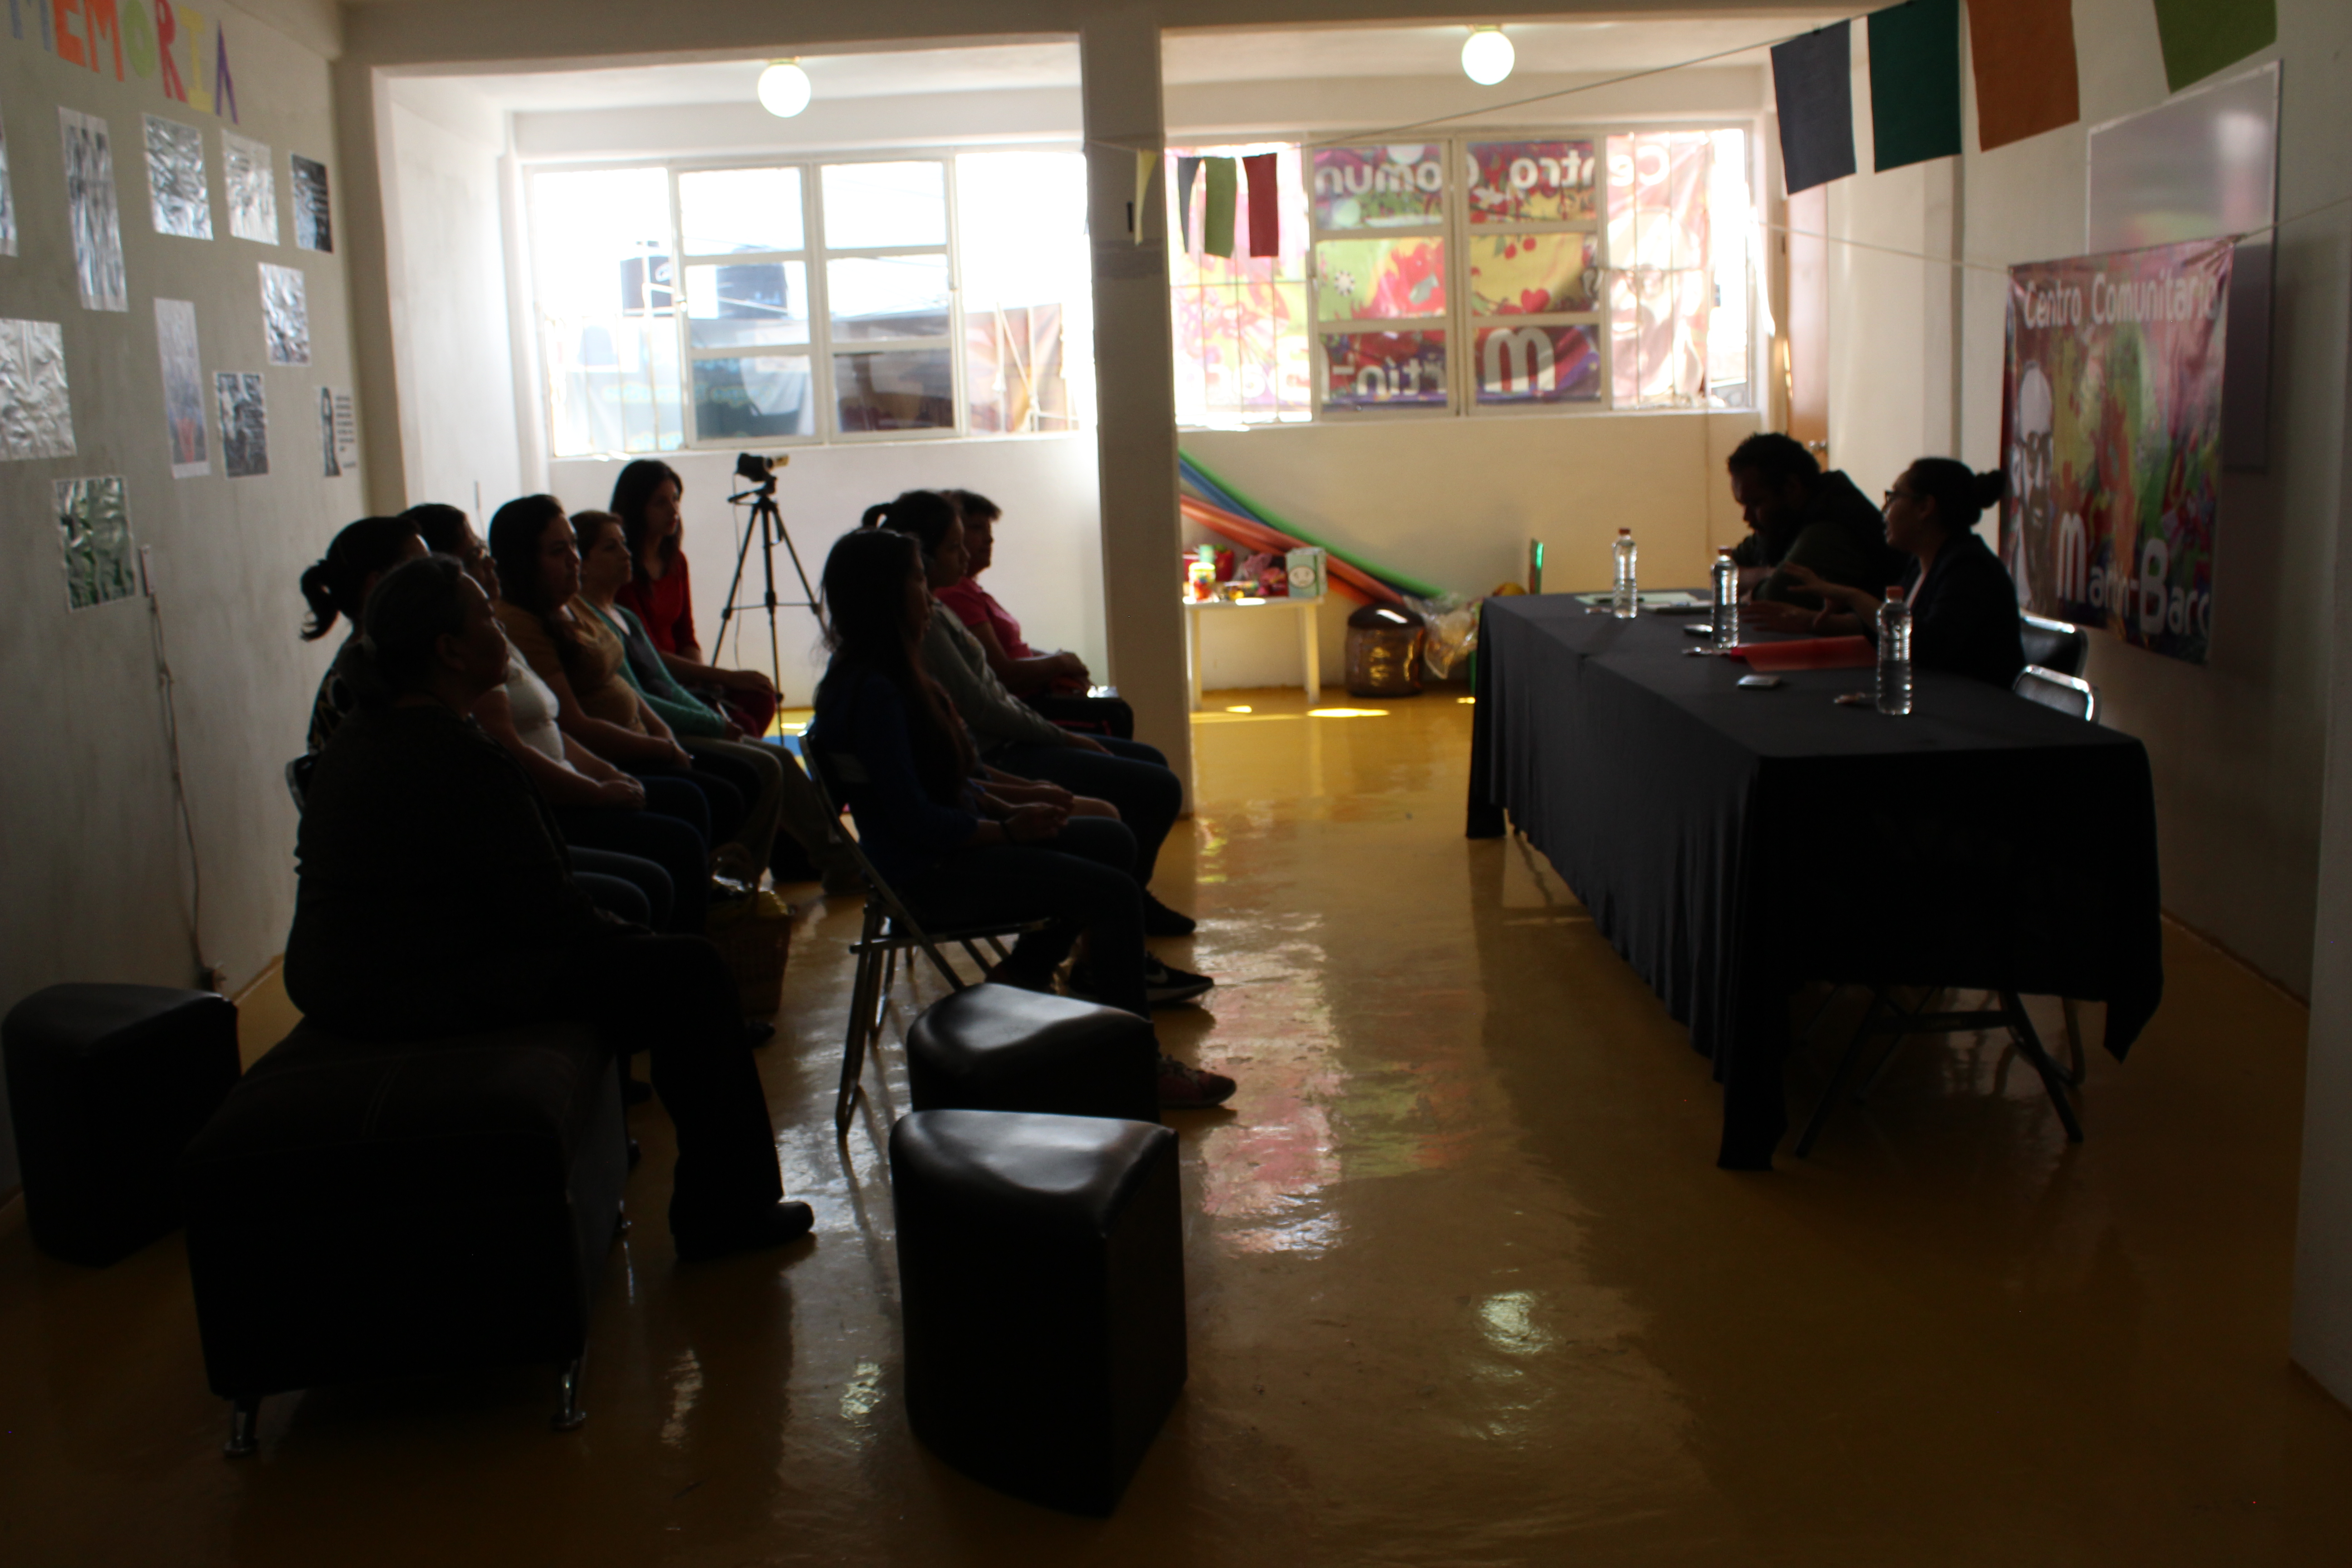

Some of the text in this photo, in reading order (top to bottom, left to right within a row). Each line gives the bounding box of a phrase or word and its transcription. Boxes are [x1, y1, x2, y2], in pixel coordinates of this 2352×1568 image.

[8, 0, 239, 125] MEMORIA
[2024, 270, 2219, 329] Centro Comunitario
